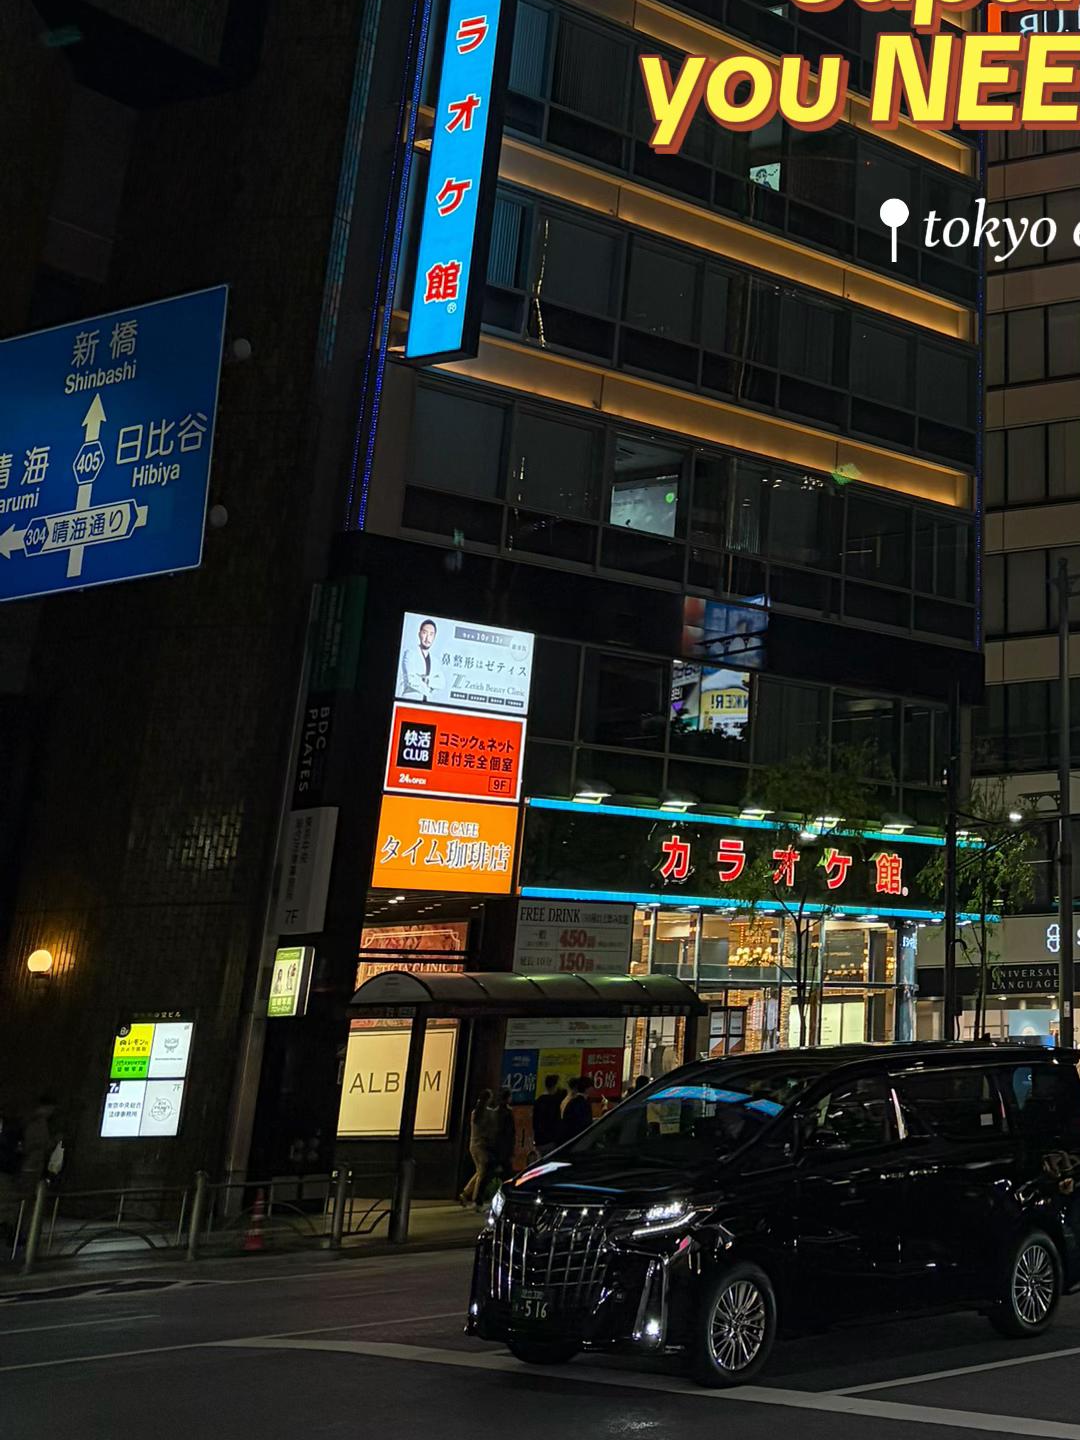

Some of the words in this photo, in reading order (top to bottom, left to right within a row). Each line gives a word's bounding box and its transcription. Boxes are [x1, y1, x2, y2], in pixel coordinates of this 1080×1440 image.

[71, 319, 139, 368] 新橋
[64, 360, 138, 395] Shinbashi
[116, 412, 208, 465] 日比谷
[76, 453, 101, 473] 405
[131, 462, 180, 488] Hibiya
[25, 526, 46, 545] 304
[51, 509, 125, 544] 晴海通り
[404, 728, 431, 749] 快活
[438, 732, 514, 753] コミック&ネット
[402, 747, 430, 763] CLUB
[437, 750, 513, 773] 鍵付完全個室
[493, 779, 508, 791] 9F
[418, 818, 449, 836] TIME
[449, 820, 480, 838] CAFE
[380, 835, 511, 872] タイム珈琲店
[660, 835, 903, 896] カラオケ館
[520, 906, 546, 922] FREE
[548, 908, 581, 923] DRINK
[991, 980, 1060, 990] LANGUAGE
[349, 1070, 442, 1094] ALBM
